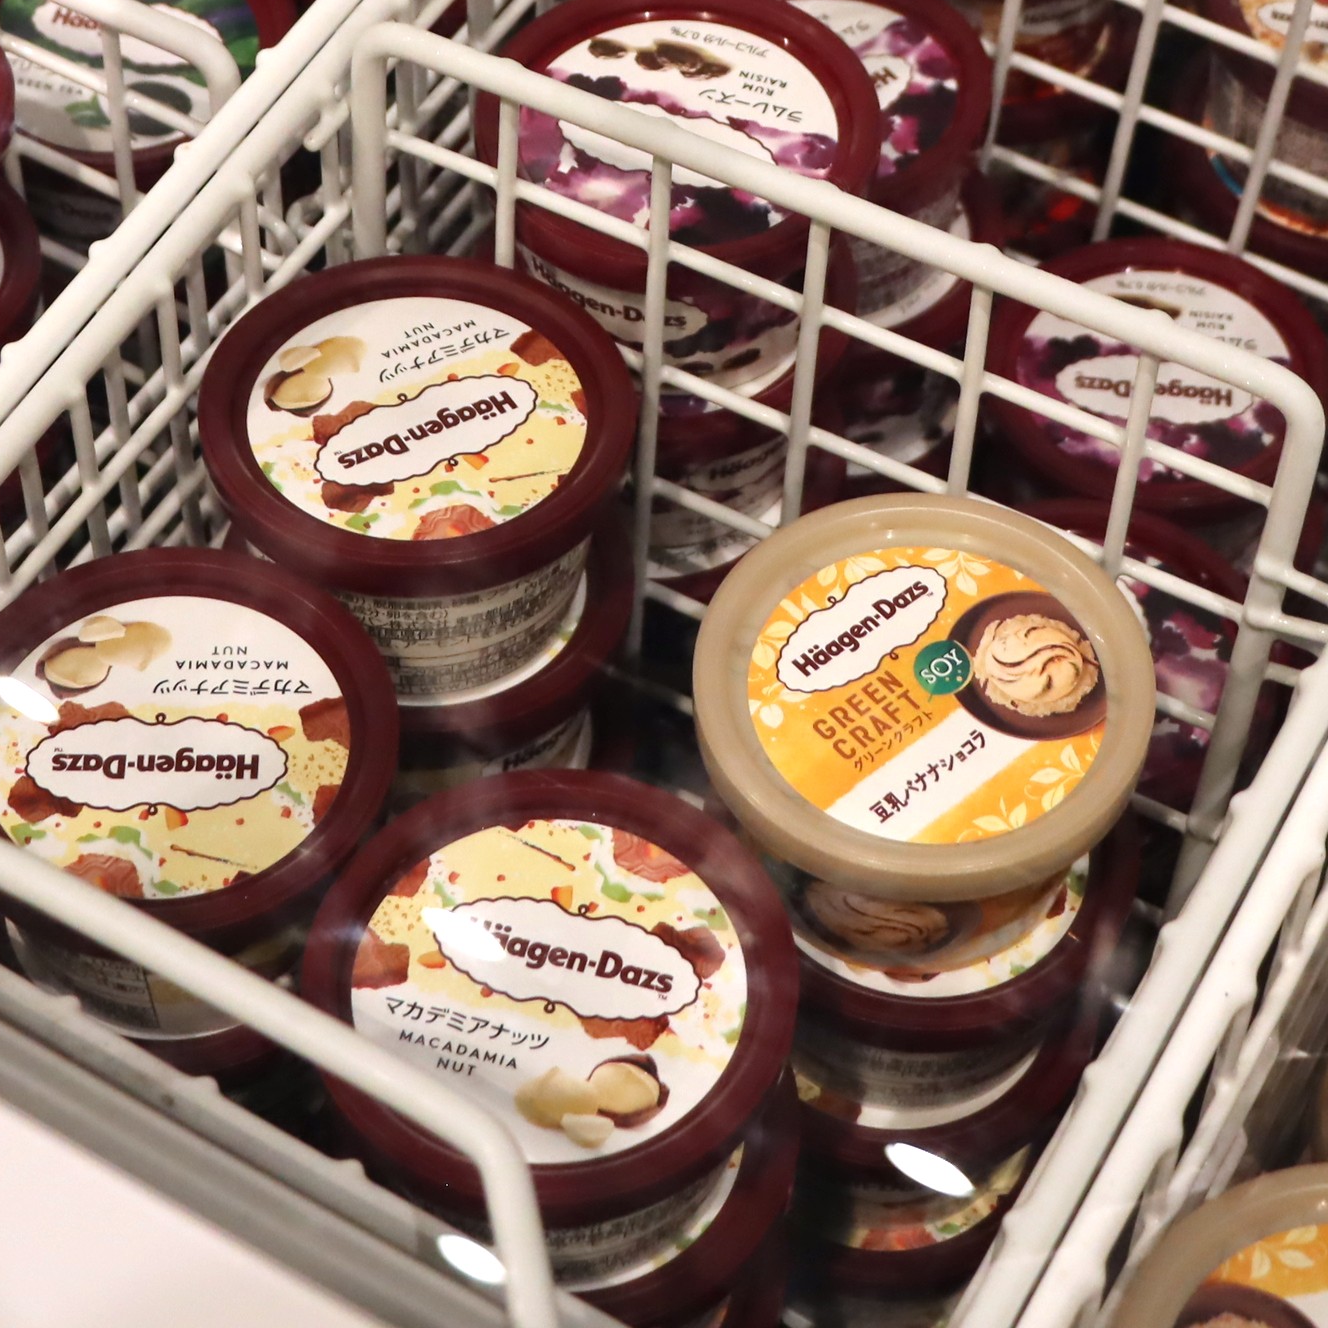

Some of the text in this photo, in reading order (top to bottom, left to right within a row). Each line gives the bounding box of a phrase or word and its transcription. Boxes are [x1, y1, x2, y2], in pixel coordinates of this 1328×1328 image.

[698, 69, 748, 90] RAISIN
[701, 82, 735, 97] RUM
[658, 88, 804, 123] ラムレーズン
[380, 319, 477, 359] MACADAMIA
[403, 322, 436, 340] NUT
[378, 327, 511, 383] マカデミアナッツ
[337, 390, 519, 470] Häagen-Dazs
[791, 580, 930, 678] Häagen-Dazs
[175, 660, 289, 670] MACADAMIA
[211, 645, 248, 655] NUT
[919, 647, 964, 684] SOY
[152, 678, 313, 696] マカデミアナッツ
[812, 669, 905, 740] GREEN
[832, 688, 921, 761] CRAFT
[853, 709, 935, 773] グリーンクラフト
[51, 747, 260, 780] Häagen-Dazs
[868, 728, 987, 824] 豆乳バナナショコラ
[472, 916, 675, 994] äagen-Dazs
[384, 996, 551, 1050] マカデミアナッツ
[398, 1028, 518, 1070] MACADAMIA
[435, 1056, 476, 1077] NUT
